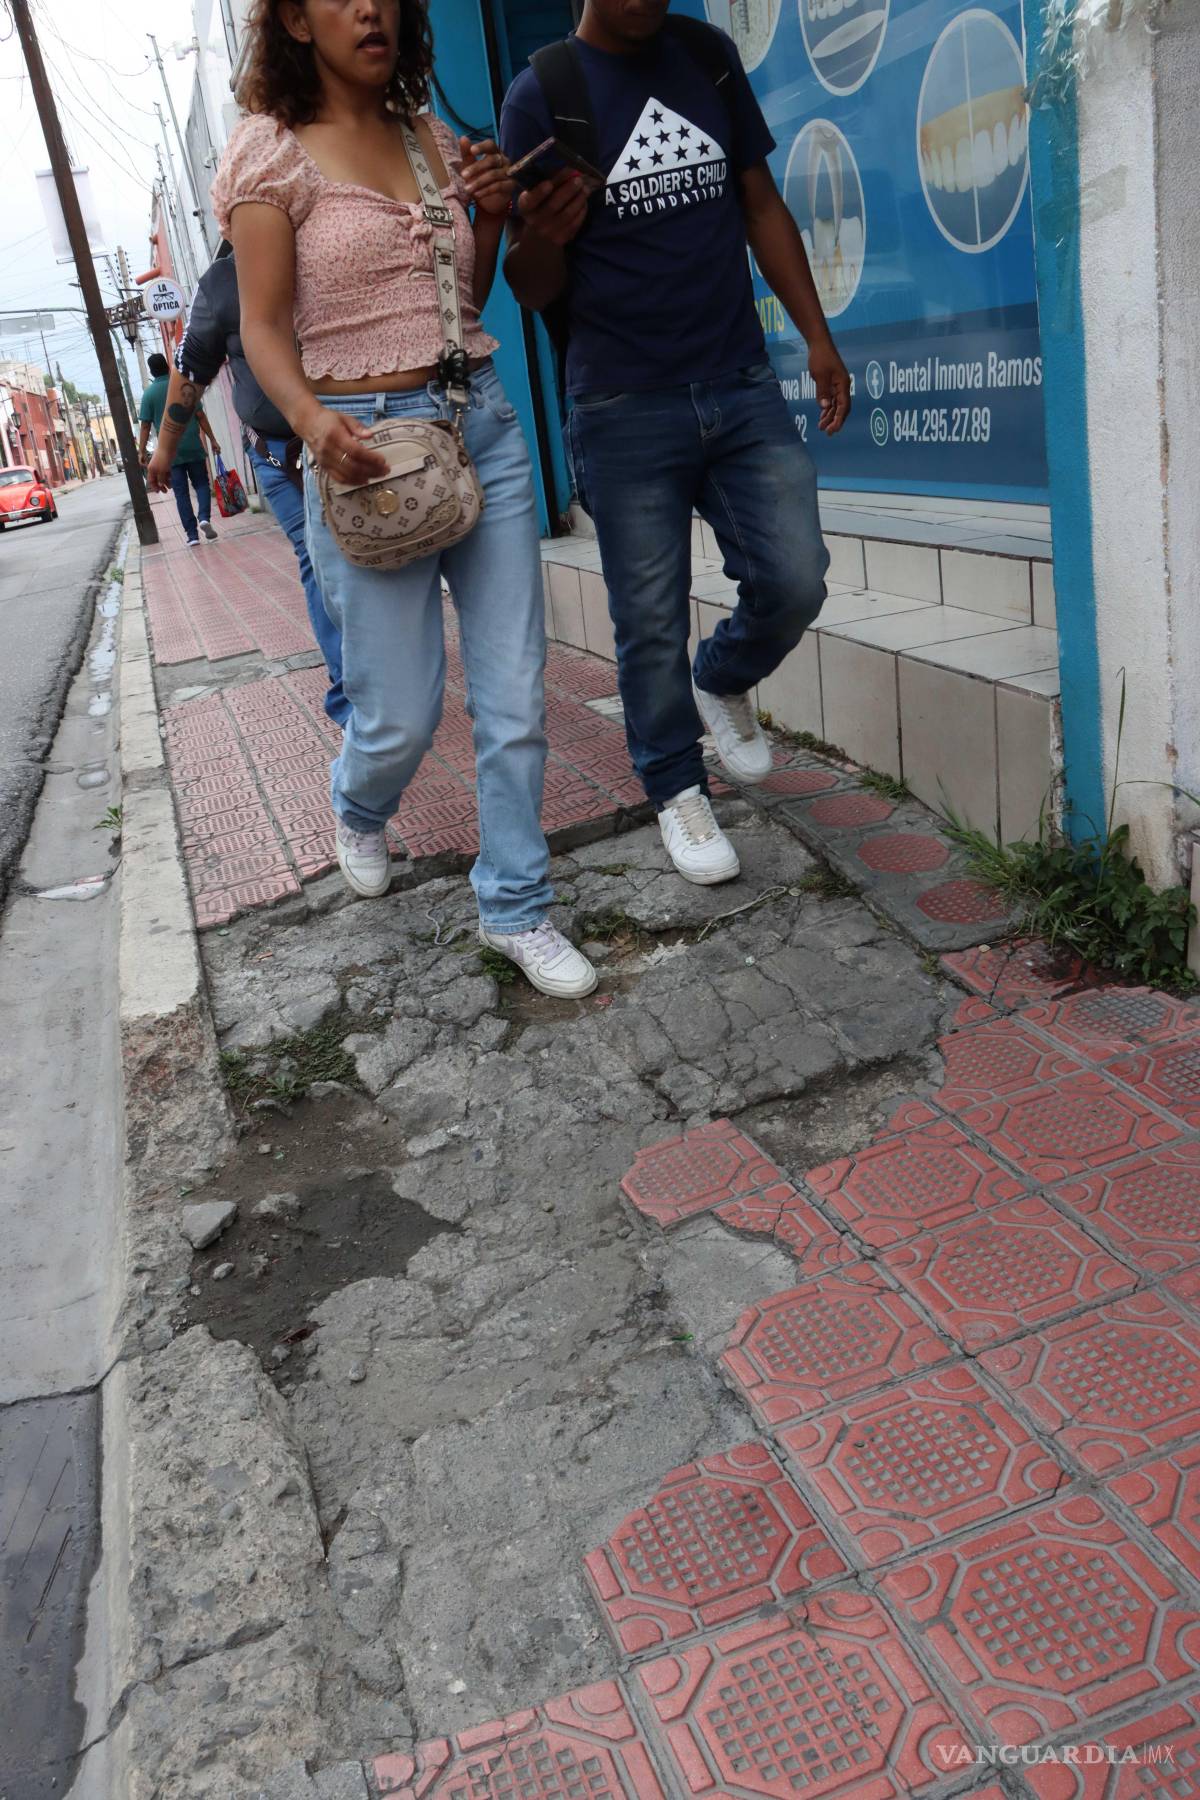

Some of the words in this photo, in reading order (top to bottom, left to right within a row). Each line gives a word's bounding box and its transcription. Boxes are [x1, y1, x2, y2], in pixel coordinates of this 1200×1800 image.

[605, 187, 616, 206] A
[619, 169, 693, 203] SOLDIER'S
[697, 162, 727, 186] CHILD
[617, 185, 723, 219] FOUNDATION
[158, 283, 167, 292] LA
[889, 357, 931, 394] Dental
[935, 356, 983, 391] Innova
[987, 351, 1043, 388] Ramos
[893, 406, 991, 443] 844.295.27.89
